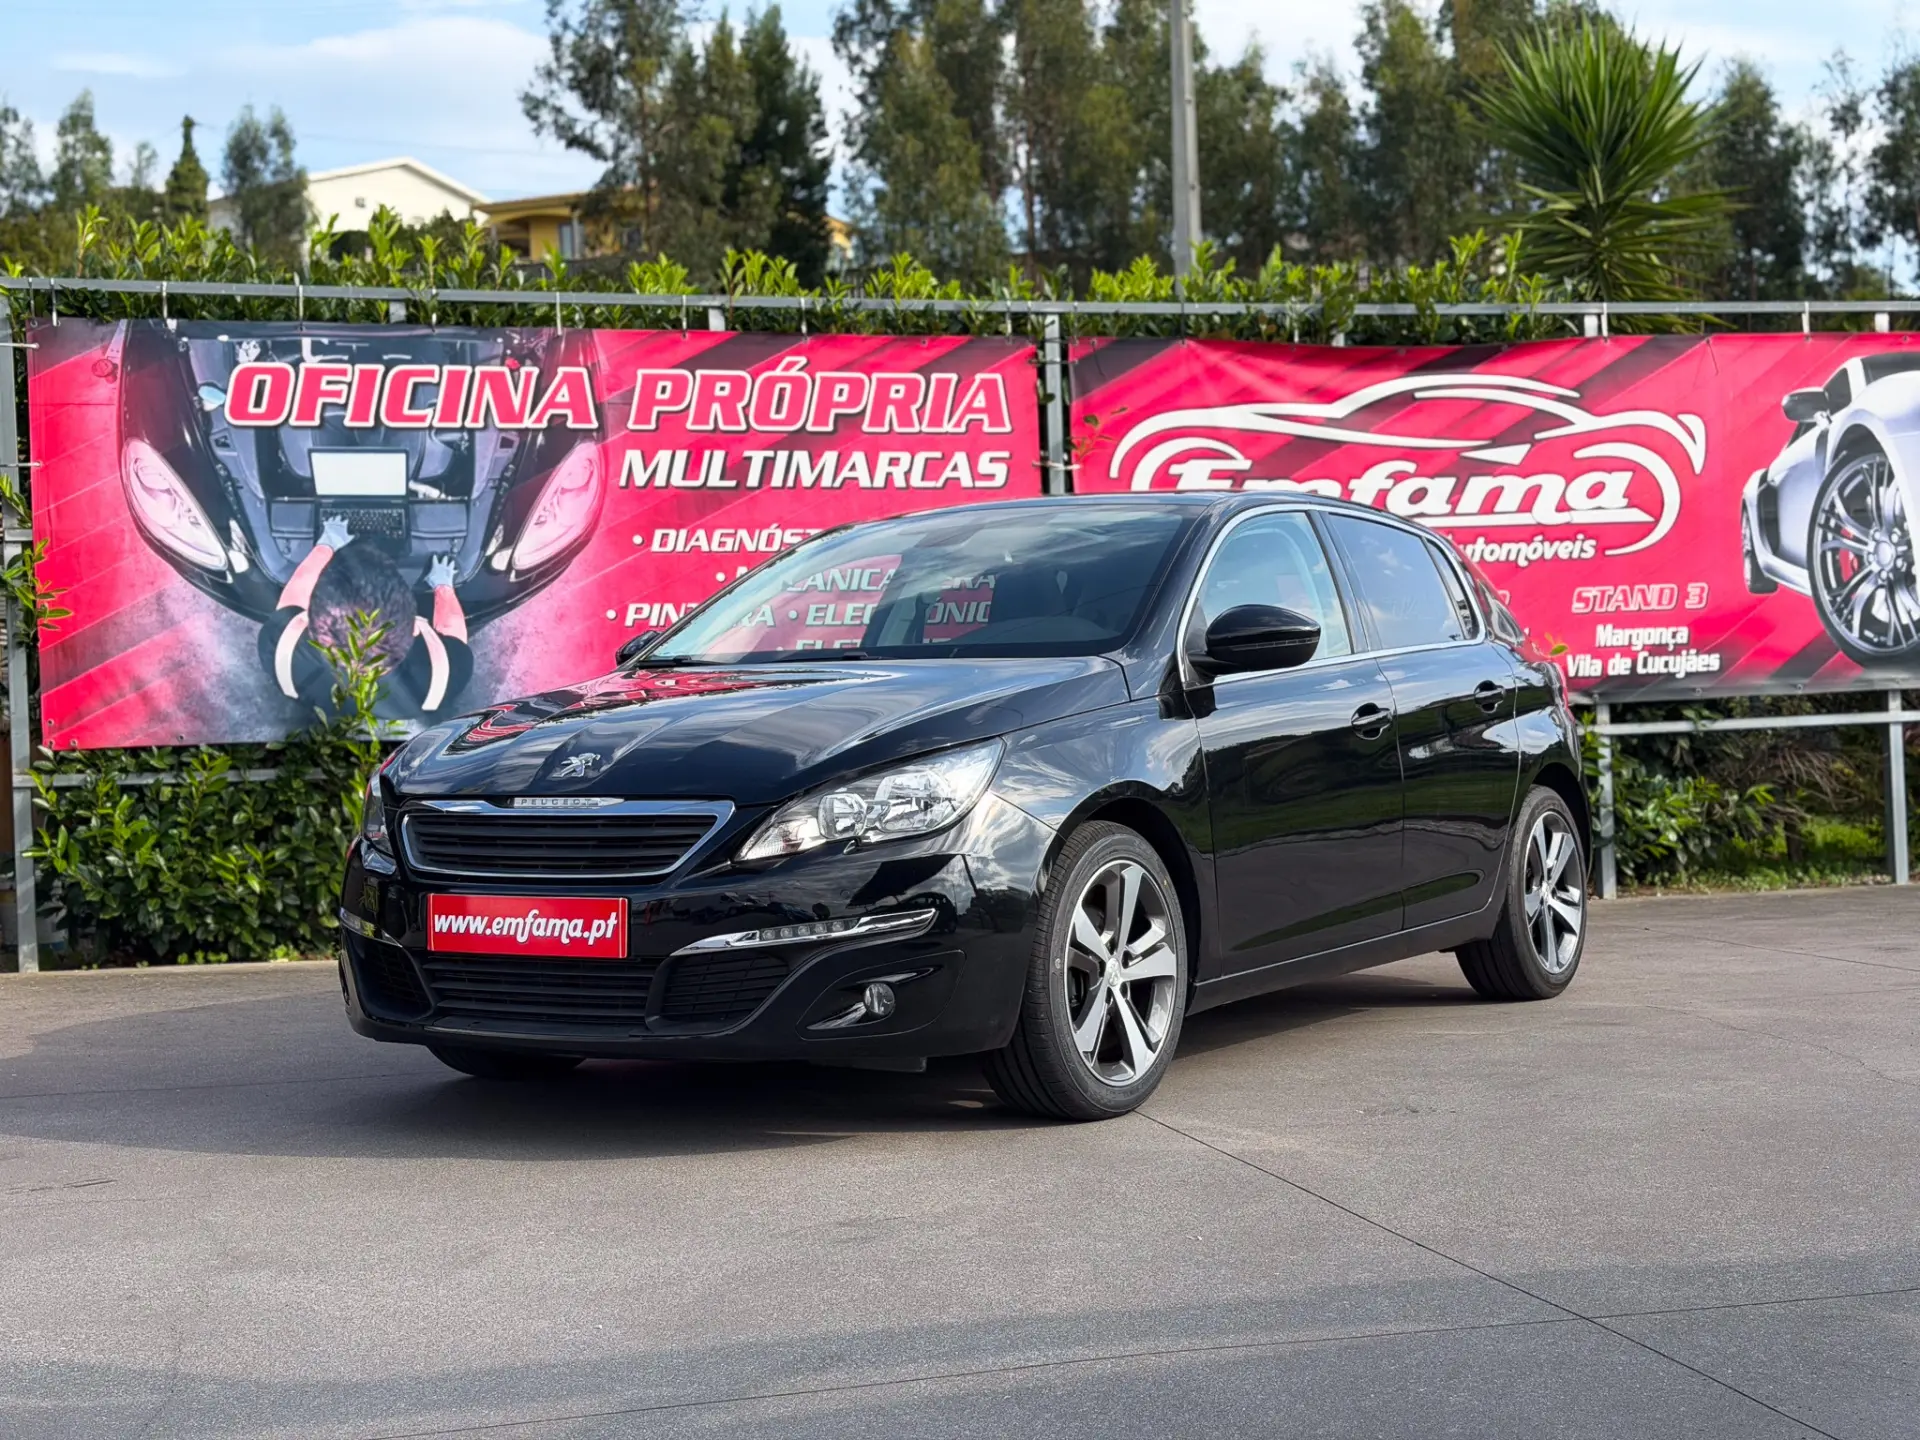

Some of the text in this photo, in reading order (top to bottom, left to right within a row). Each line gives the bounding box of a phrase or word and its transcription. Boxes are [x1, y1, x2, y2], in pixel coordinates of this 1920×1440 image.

[224, 356, 1012, 433] OFICINA PRÓPRIA
[619, 450, 1010, 488] MULTIMARCAS
[651, 523, 825, 552] DIAGNÓS
[1448, 533, 1598, 567] utomóveis
[1571, 582, 1709, 614] STAND 3
[1596, 624, 1689, 651] Margonça
[1566, 648, 1720, 679] Vila de Cucujães
[520, 798, 593, 806] PEUGEOT
[434, 909, 618, 946] www.emfama.pt
